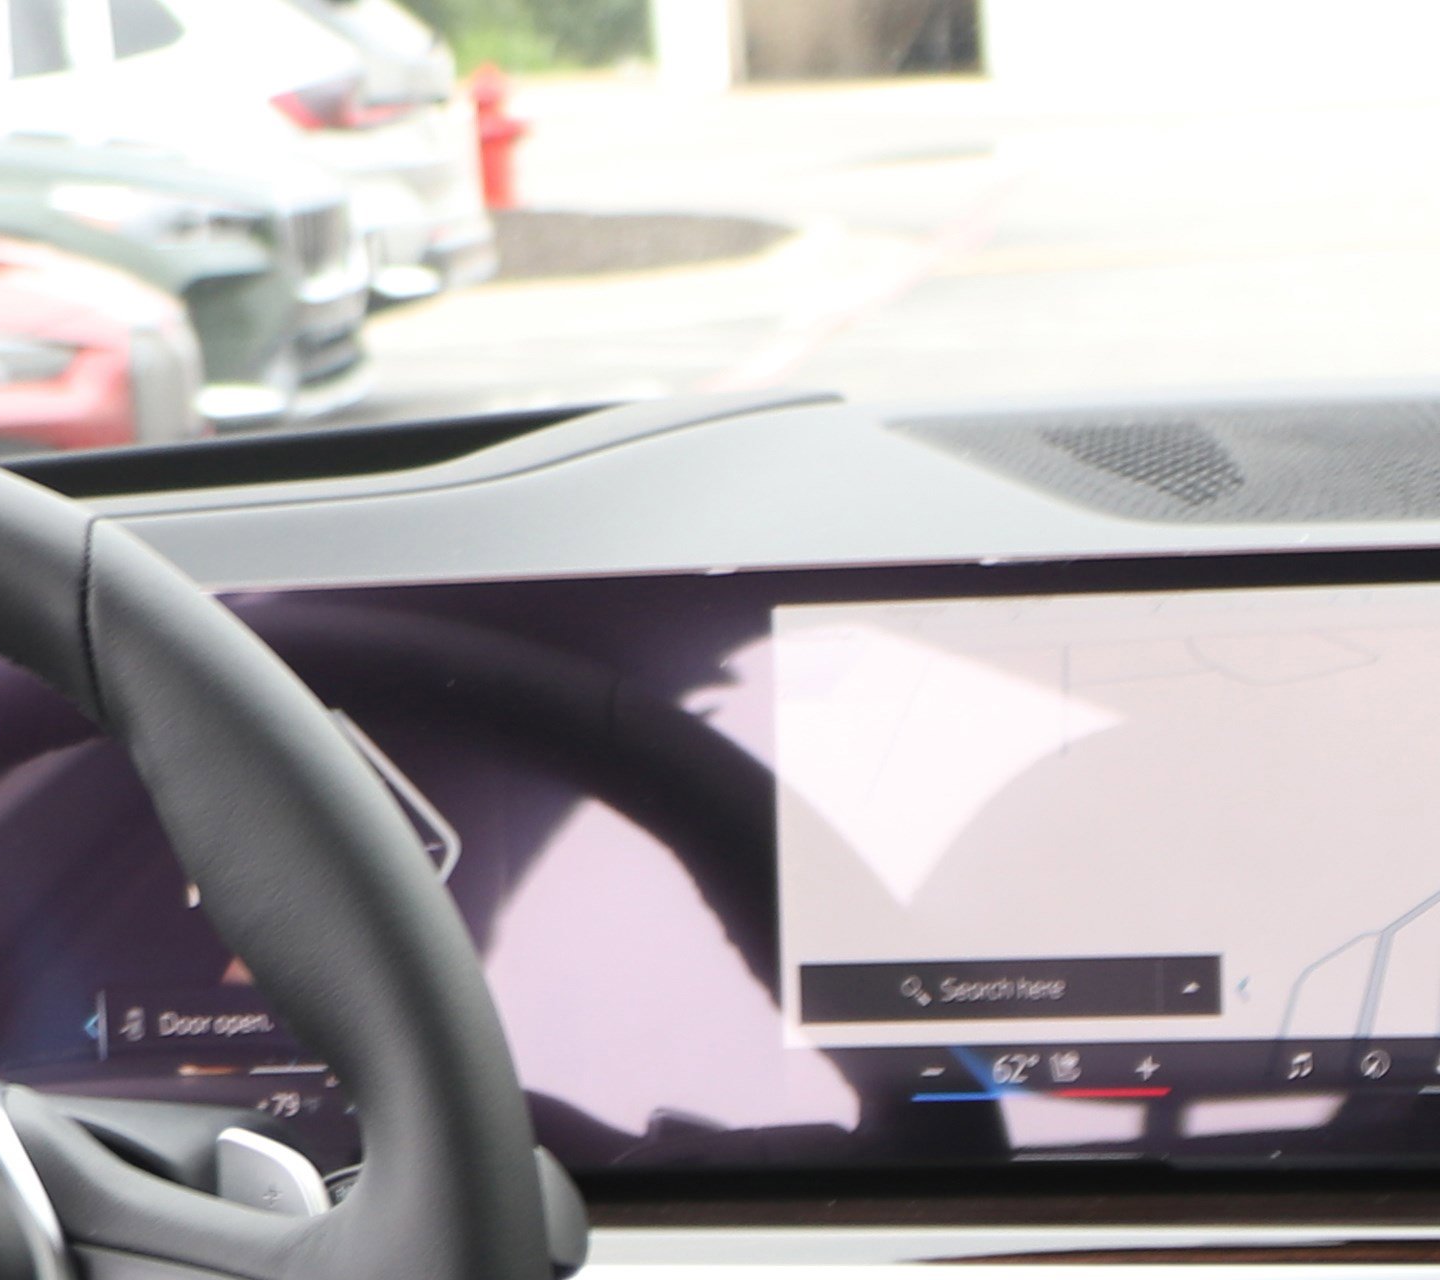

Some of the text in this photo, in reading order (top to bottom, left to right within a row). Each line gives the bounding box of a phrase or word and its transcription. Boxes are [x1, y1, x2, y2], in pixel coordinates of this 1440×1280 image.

[940, 974, 1067, 1003] Search here
[159, 1010, 212, 1037] Door
